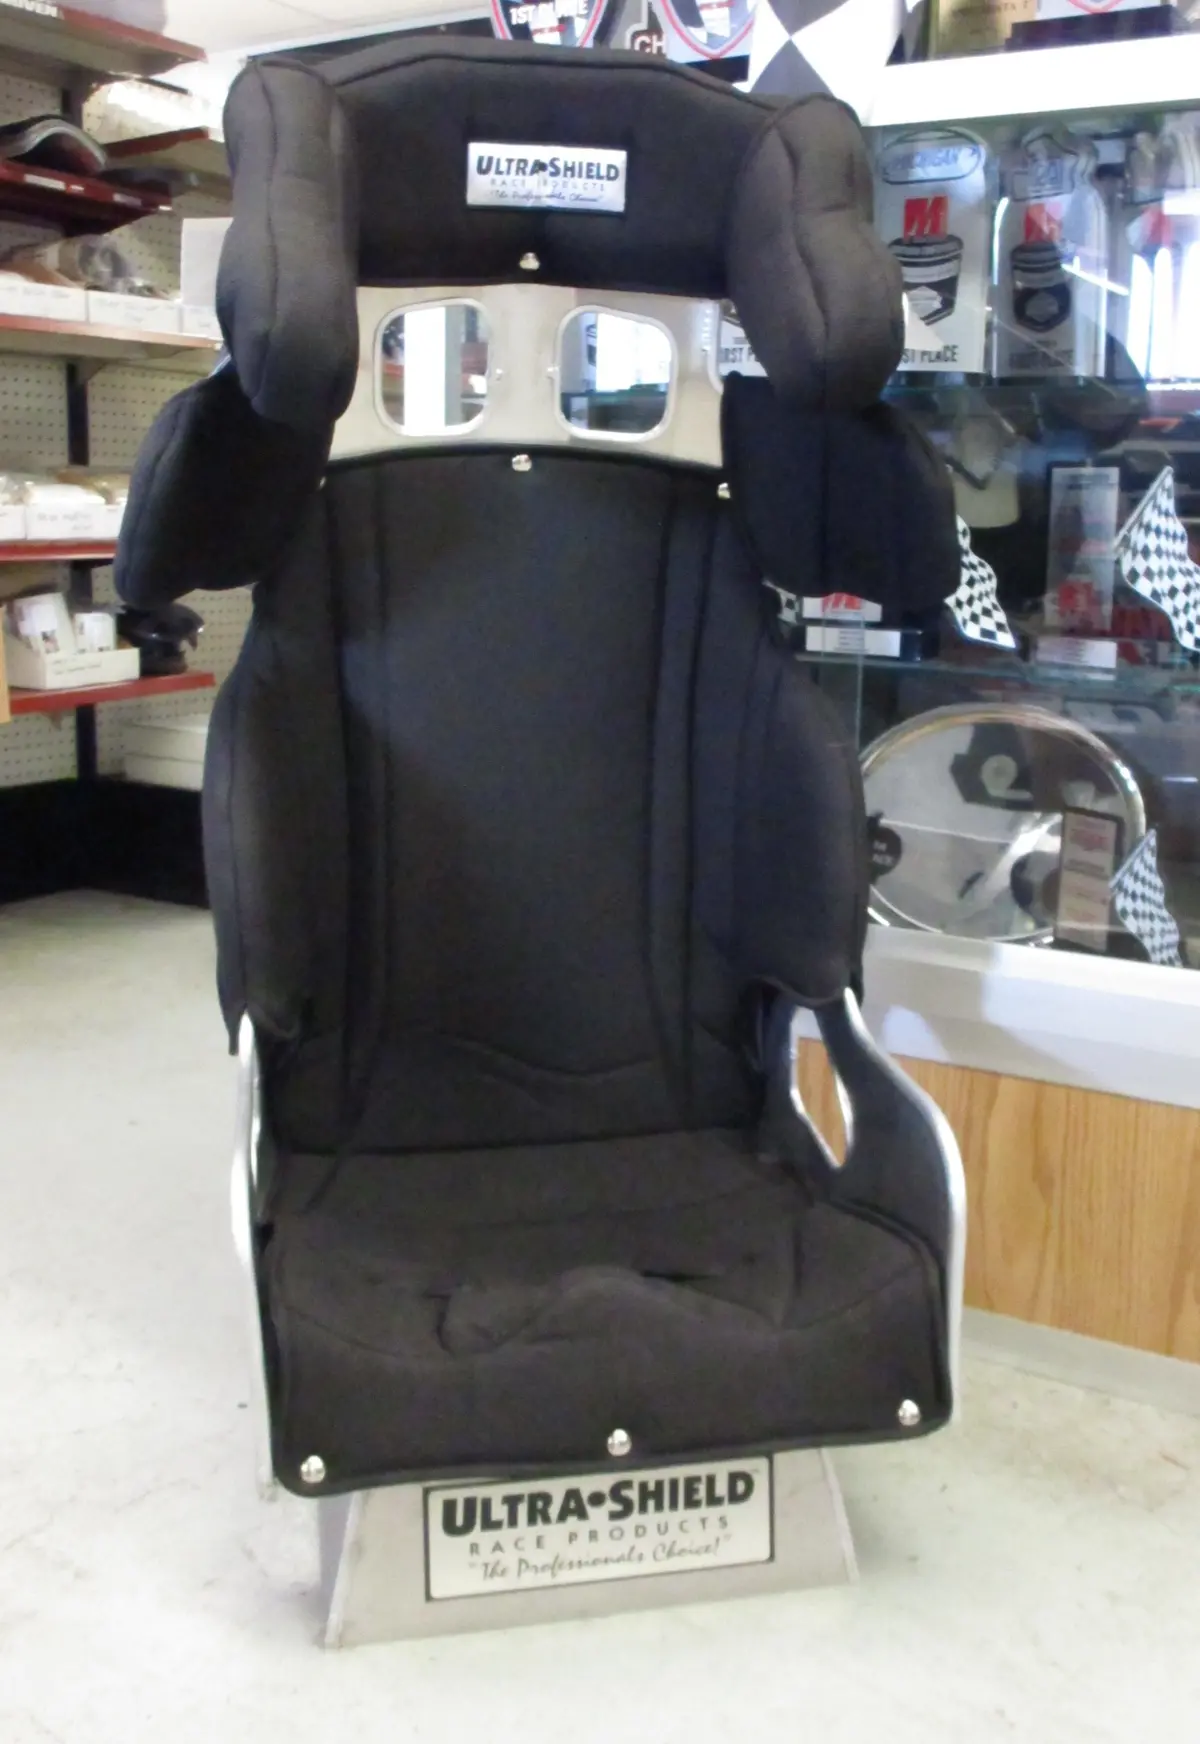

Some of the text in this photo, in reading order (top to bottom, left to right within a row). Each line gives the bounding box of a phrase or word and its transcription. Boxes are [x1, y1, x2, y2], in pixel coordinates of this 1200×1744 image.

[920, 345, 958, 363] PLACE
[470, 1515, 729, 1557] RACE PRODUCTS
[517, 1543, 645, 1580] Professionals
